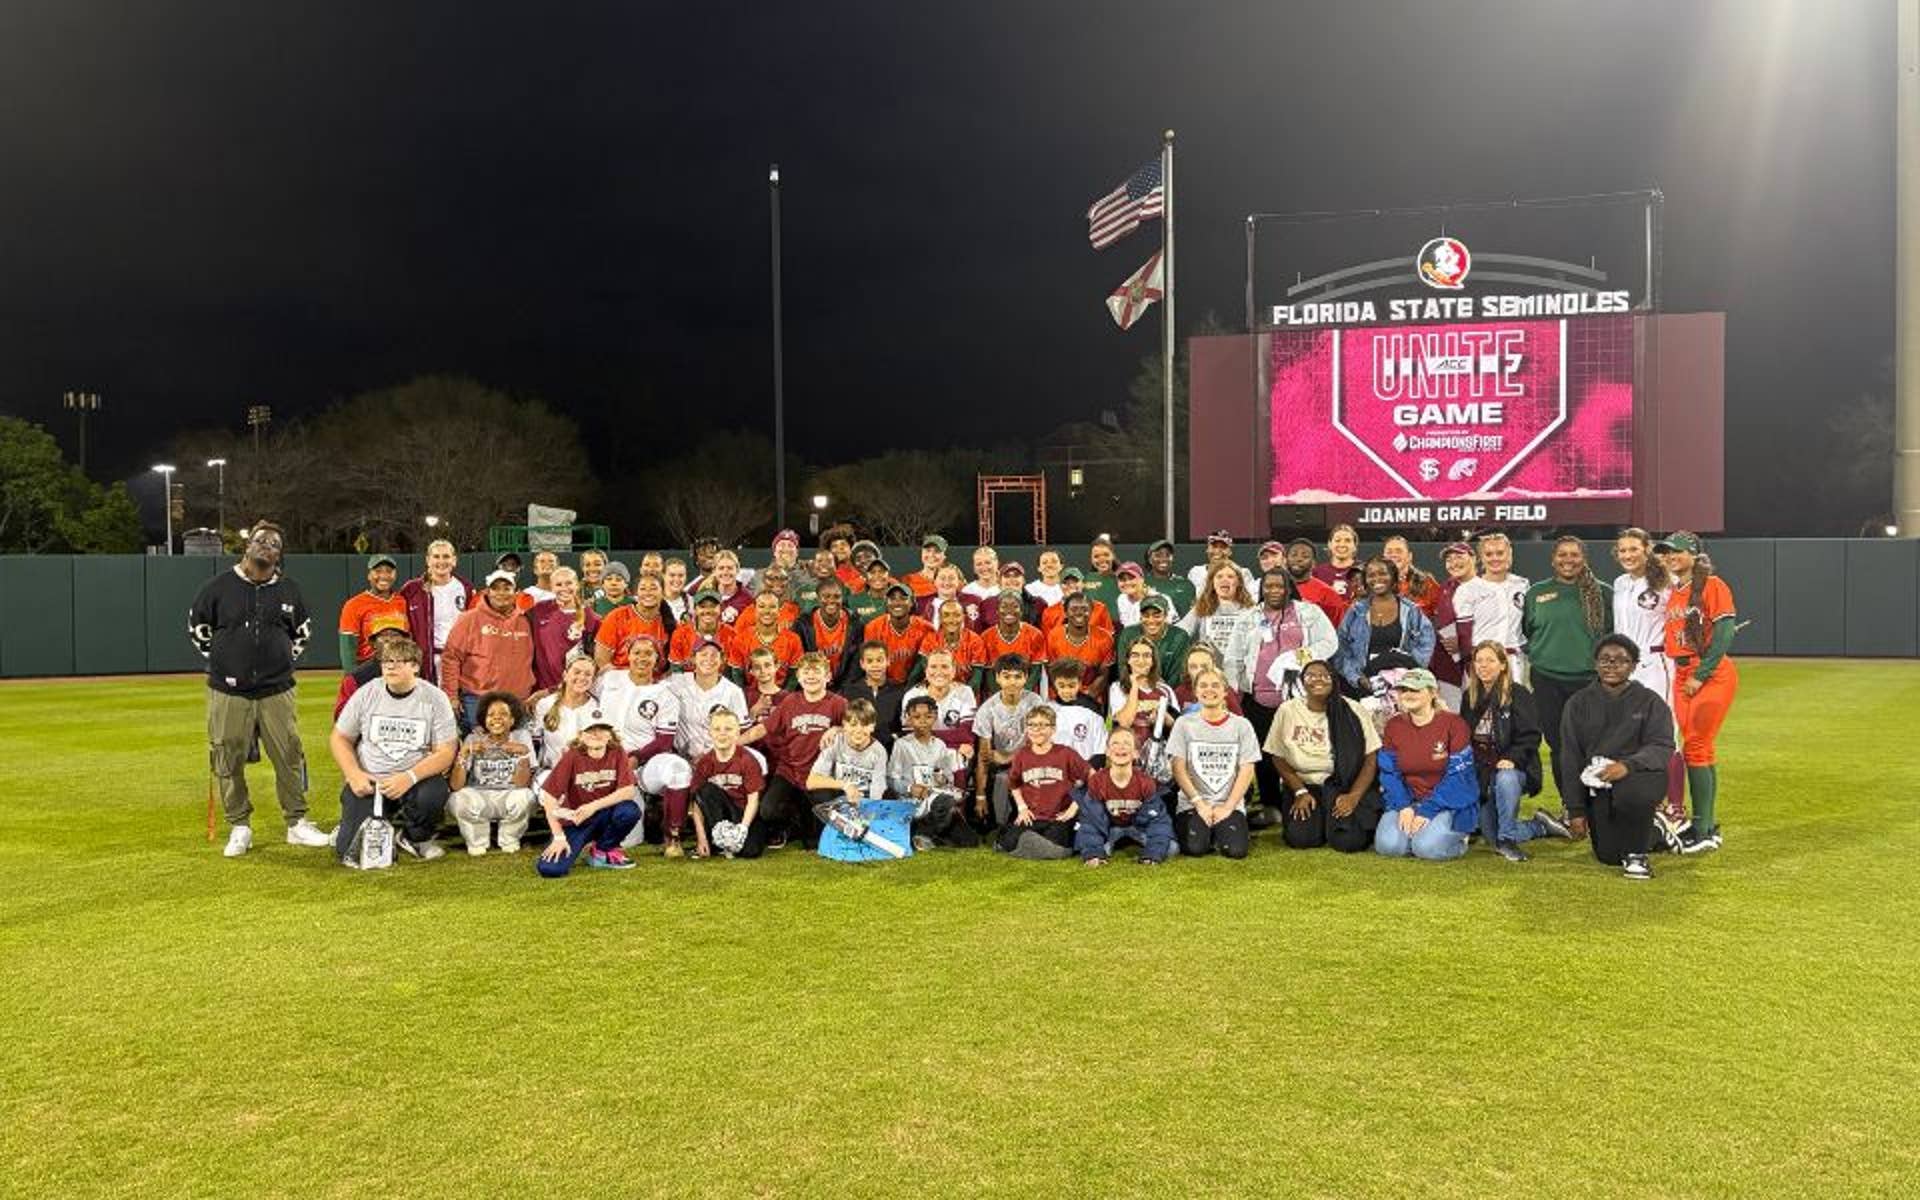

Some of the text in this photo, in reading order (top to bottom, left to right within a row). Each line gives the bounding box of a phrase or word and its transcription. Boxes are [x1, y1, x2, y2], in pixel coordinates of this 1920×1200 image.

[1273, 290, 1630, 325] FLORIDA STATE SEMINOLES
[1373, 329, 1526, 401] UNITE
[1393, 402, 1503, 426] GAME
[1358, 505, 1547, 523] JOANNE GRAF FIELD
